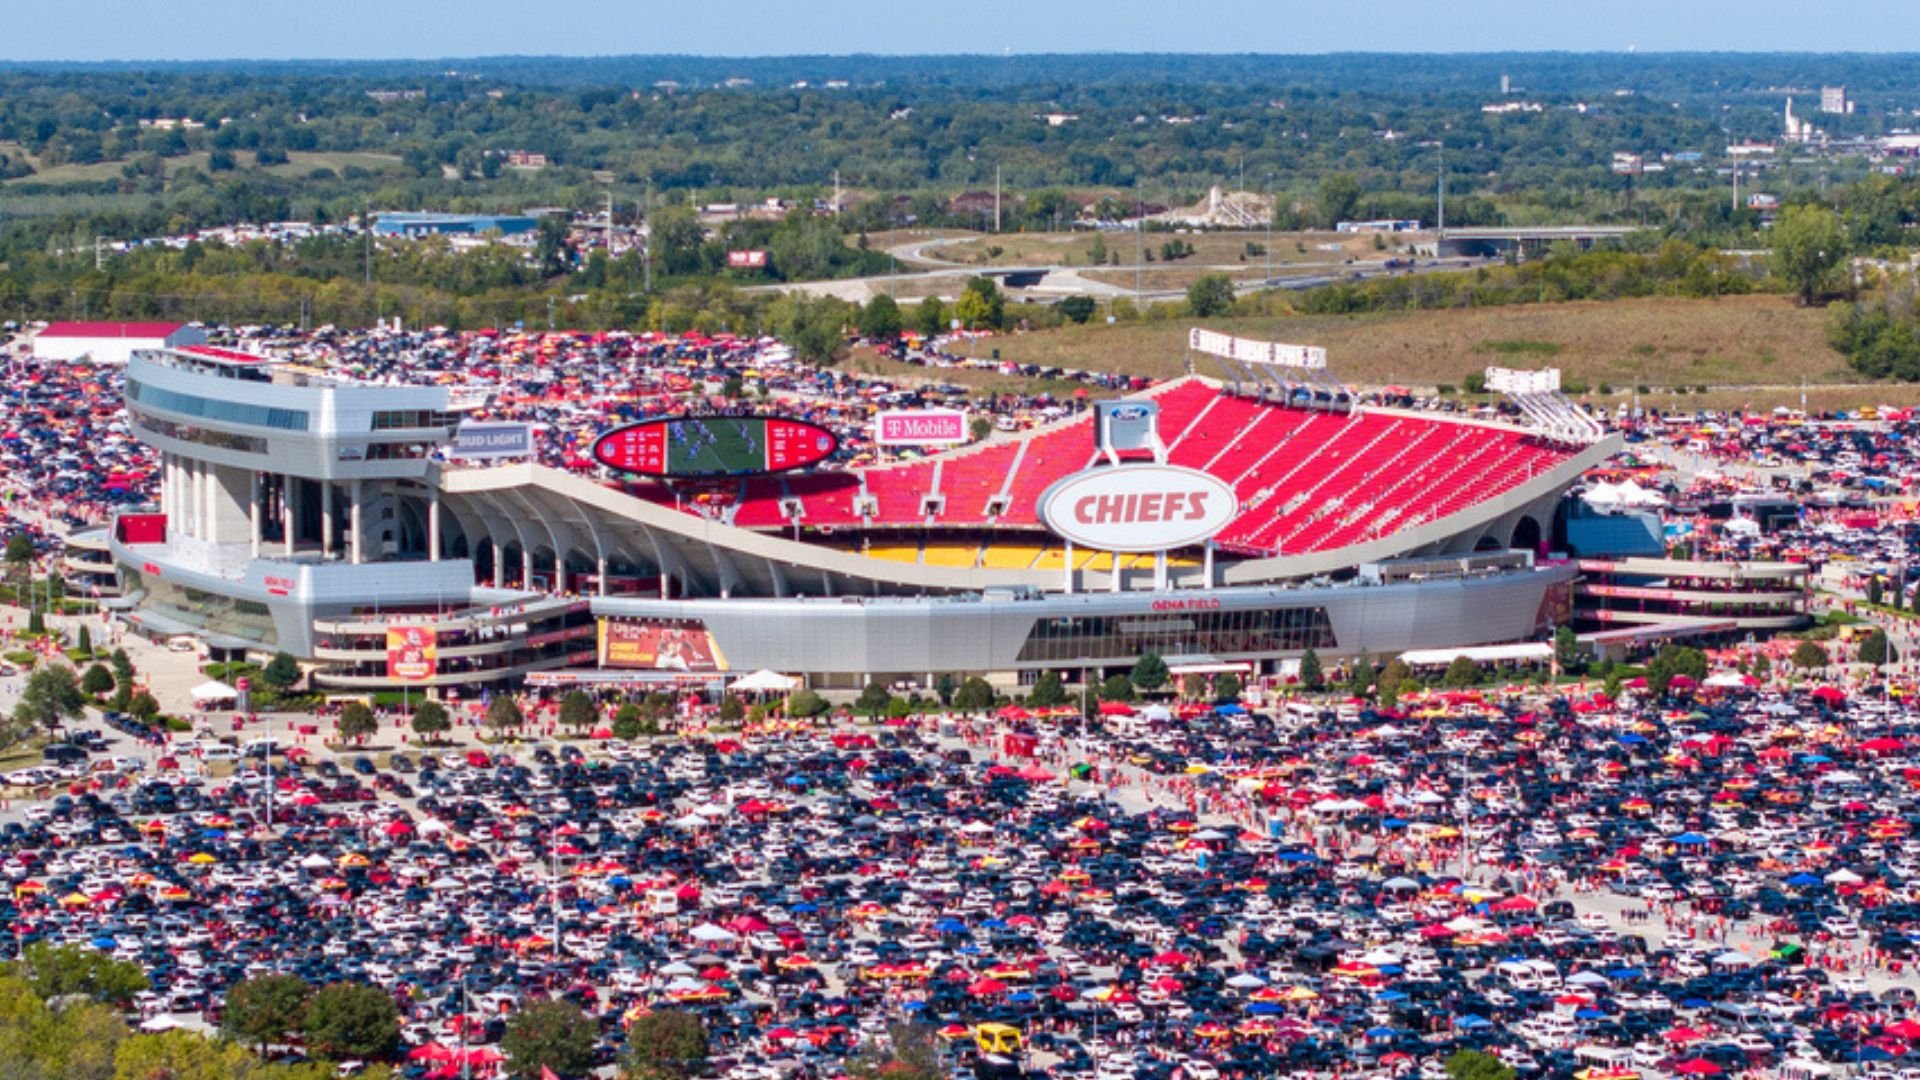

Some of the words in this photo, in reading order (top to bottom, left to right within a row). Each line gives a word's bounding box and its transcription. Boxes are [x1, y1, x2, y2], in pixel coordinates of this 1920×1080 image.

[903, 419, 957, 438] Mobile
[459, 435, 484, 447] BUD
[486, 433, 524, 446] LIGHT
[1074, 491, 1209, 524] CHIEFS
